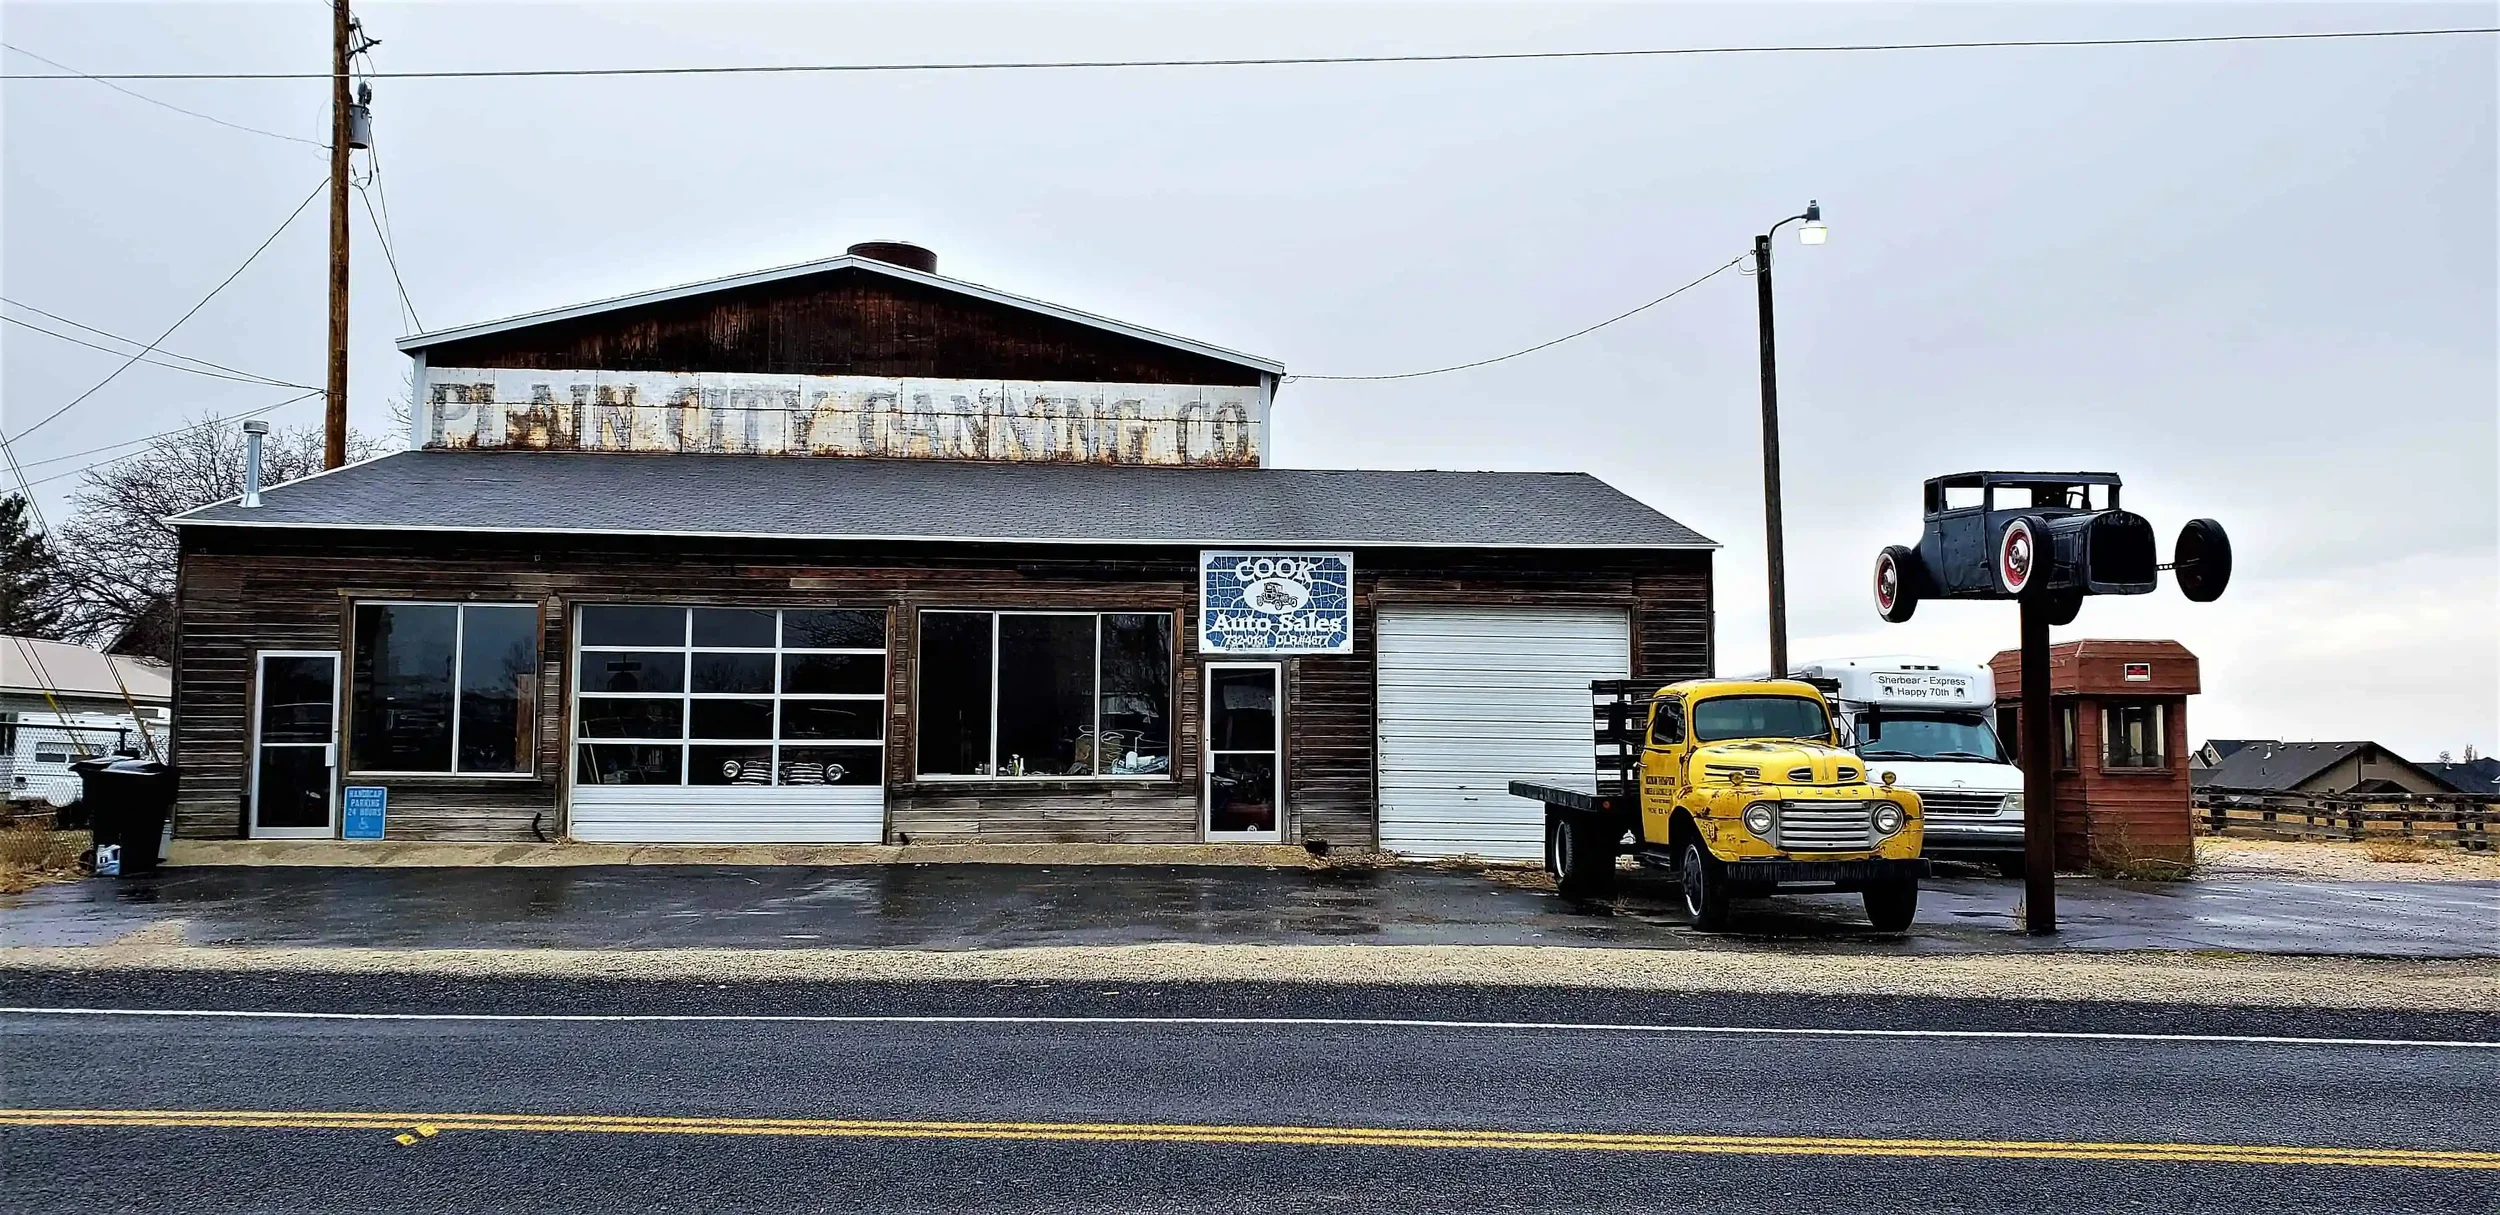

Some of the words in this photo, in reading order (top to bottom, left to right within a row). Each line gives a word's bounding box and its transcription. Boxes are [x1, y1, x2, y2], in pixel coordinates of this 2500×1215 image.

[430, 383, 638, 451] PLAIN
[666, 386, 829, 456] CITY
[858, 389, 1151, 463] CANNING
[1235, 558, 1314, 582] COOK
[1212, 613, 1272, 632] Auto
[1279, 612, 1342, 632] Sales
[1878, 675, 1921, 685] Sherbear
[1929, 676, 1966, 686] Express
[1897, 687, 1928, 698] Happy
[1929, 687, 1950, 697] 70th
